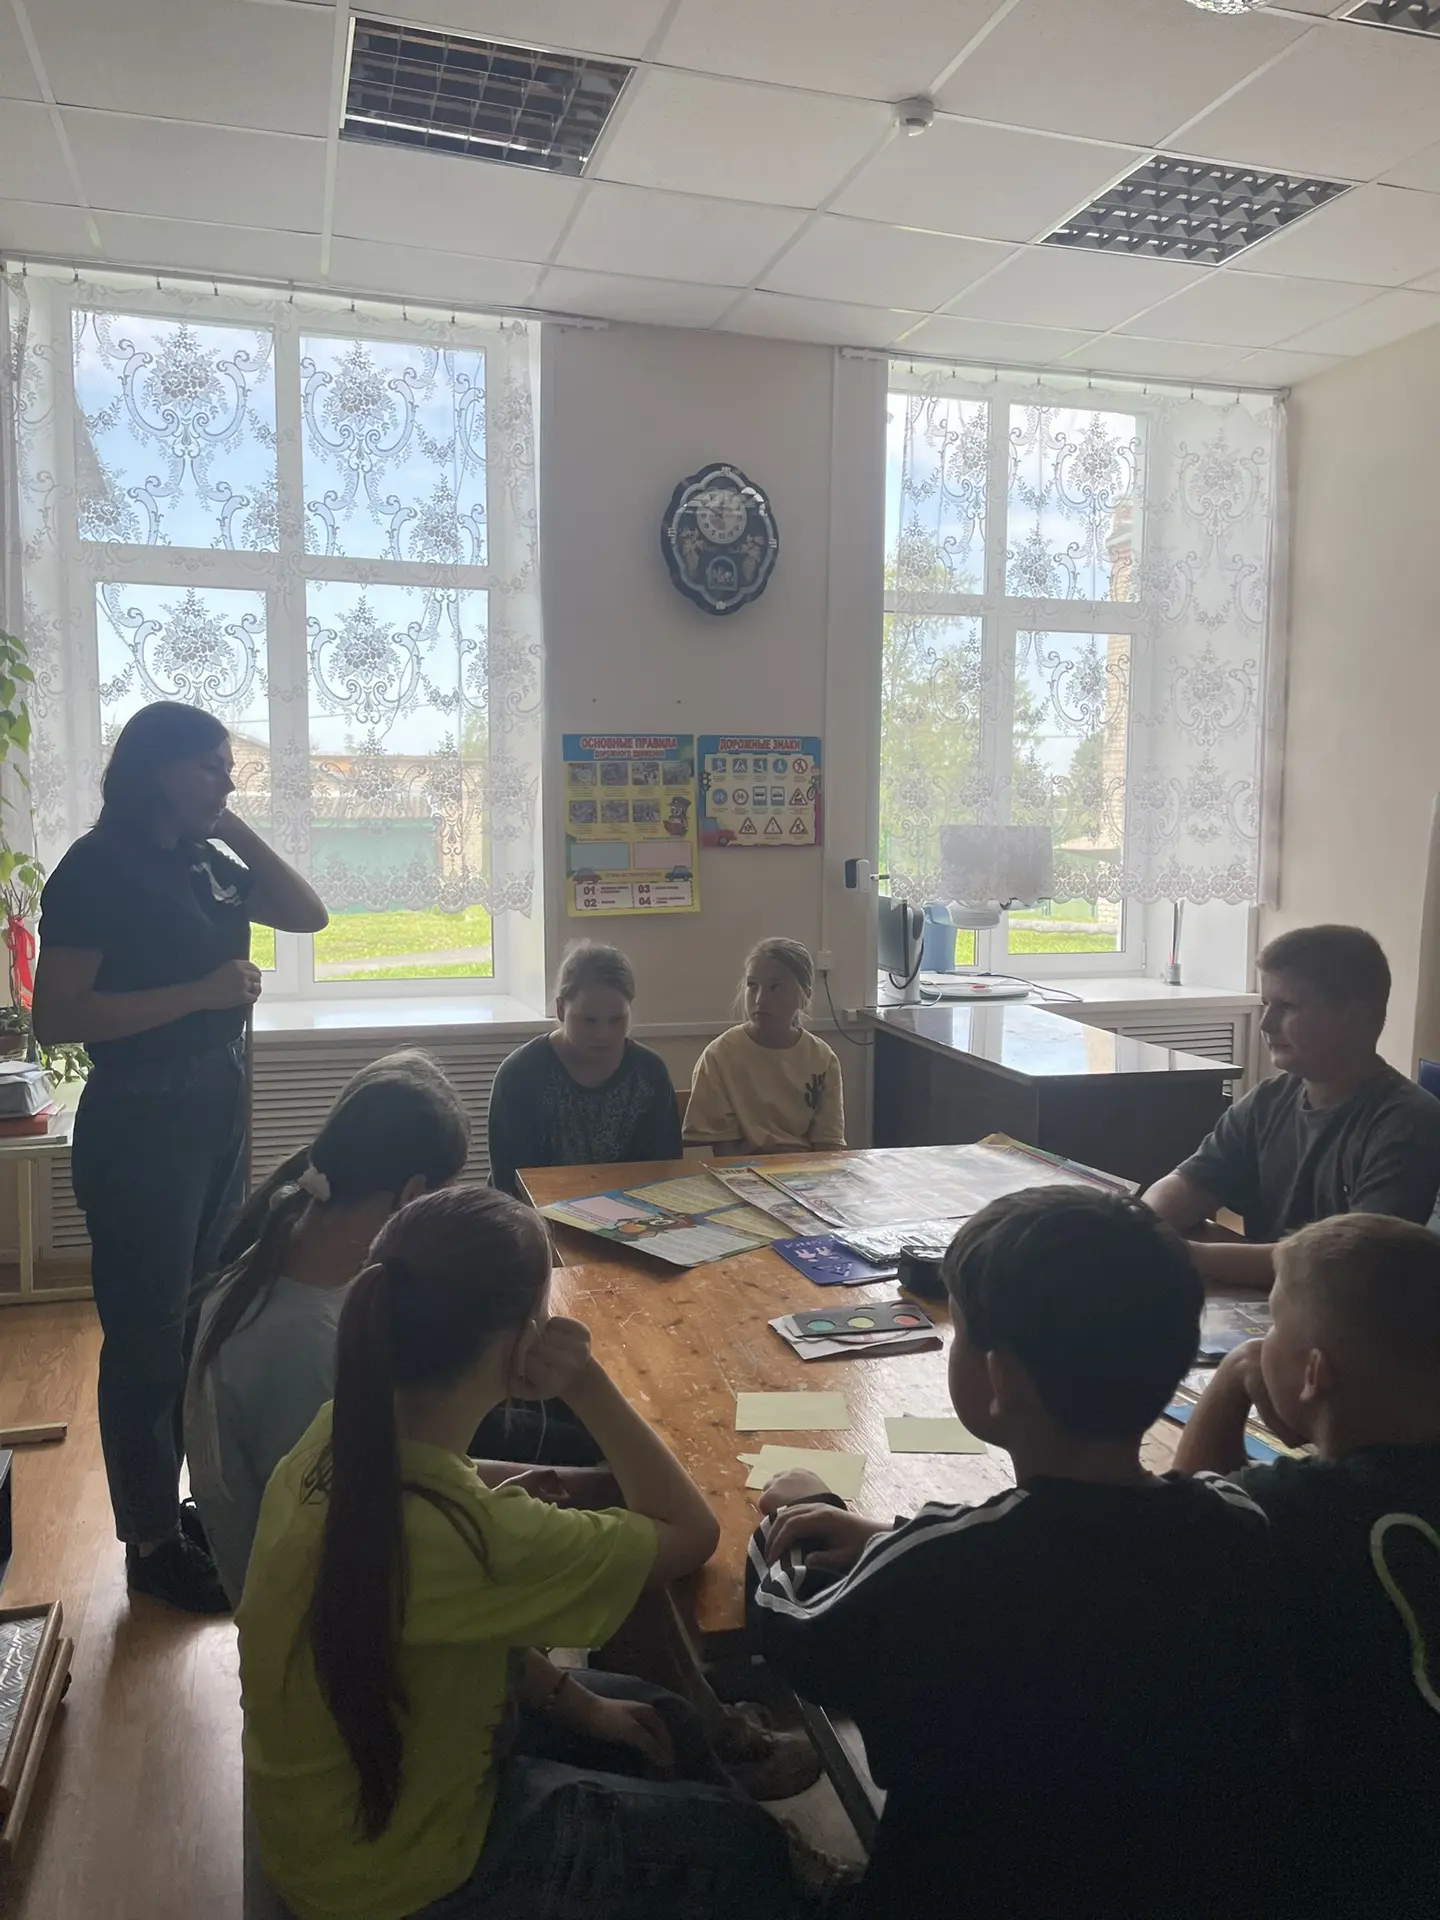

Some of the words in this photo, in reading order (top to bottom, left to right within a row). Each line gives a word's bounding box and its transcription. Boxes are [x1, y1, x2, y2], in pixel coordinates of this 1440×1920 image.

[581, 737, 633, 748] ОСНОВНЫЕ
[634, 737, 677, 748] ПРАВИЛА
[719, 739, 772, 749] ДОРОЖНЫЕ
[774, 739, 800, 749] ЗНАКИ
[584, 886, 595, 895] 01
[638, 885, 650, 893] 03
[584, 899, 597, 907] 02
[639, 897, 652, 905] 04
